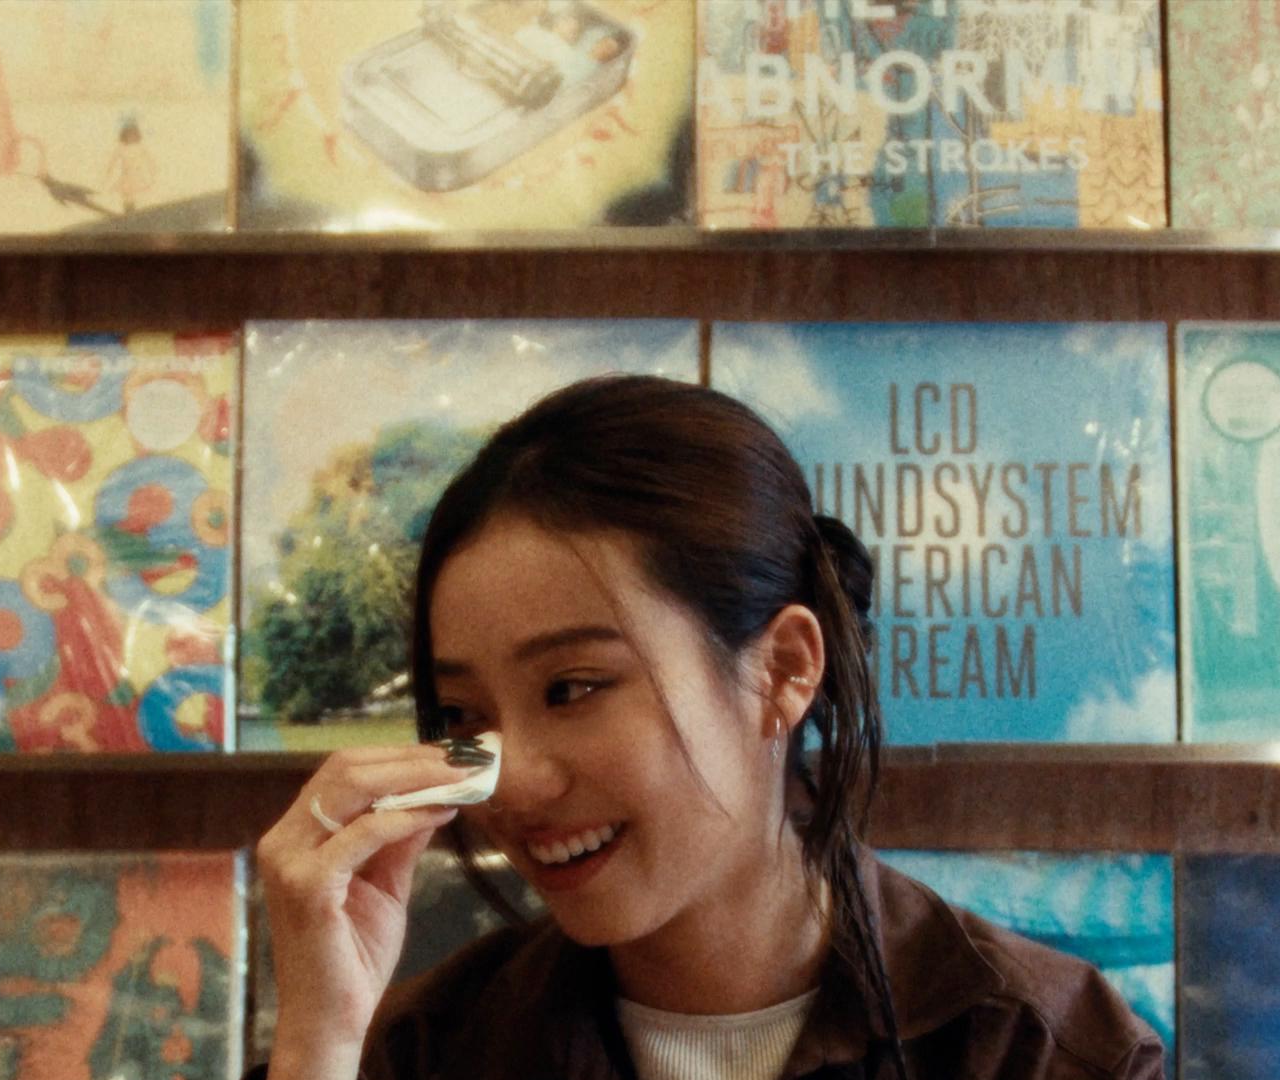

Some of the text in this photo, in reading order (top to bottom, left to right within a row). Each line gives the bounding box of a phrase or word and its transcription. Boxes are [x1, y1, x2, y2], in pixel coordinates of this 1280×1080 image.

[778, 137, 1090, 176] THE STROKES
[888, 381, 979, 455] LCD
